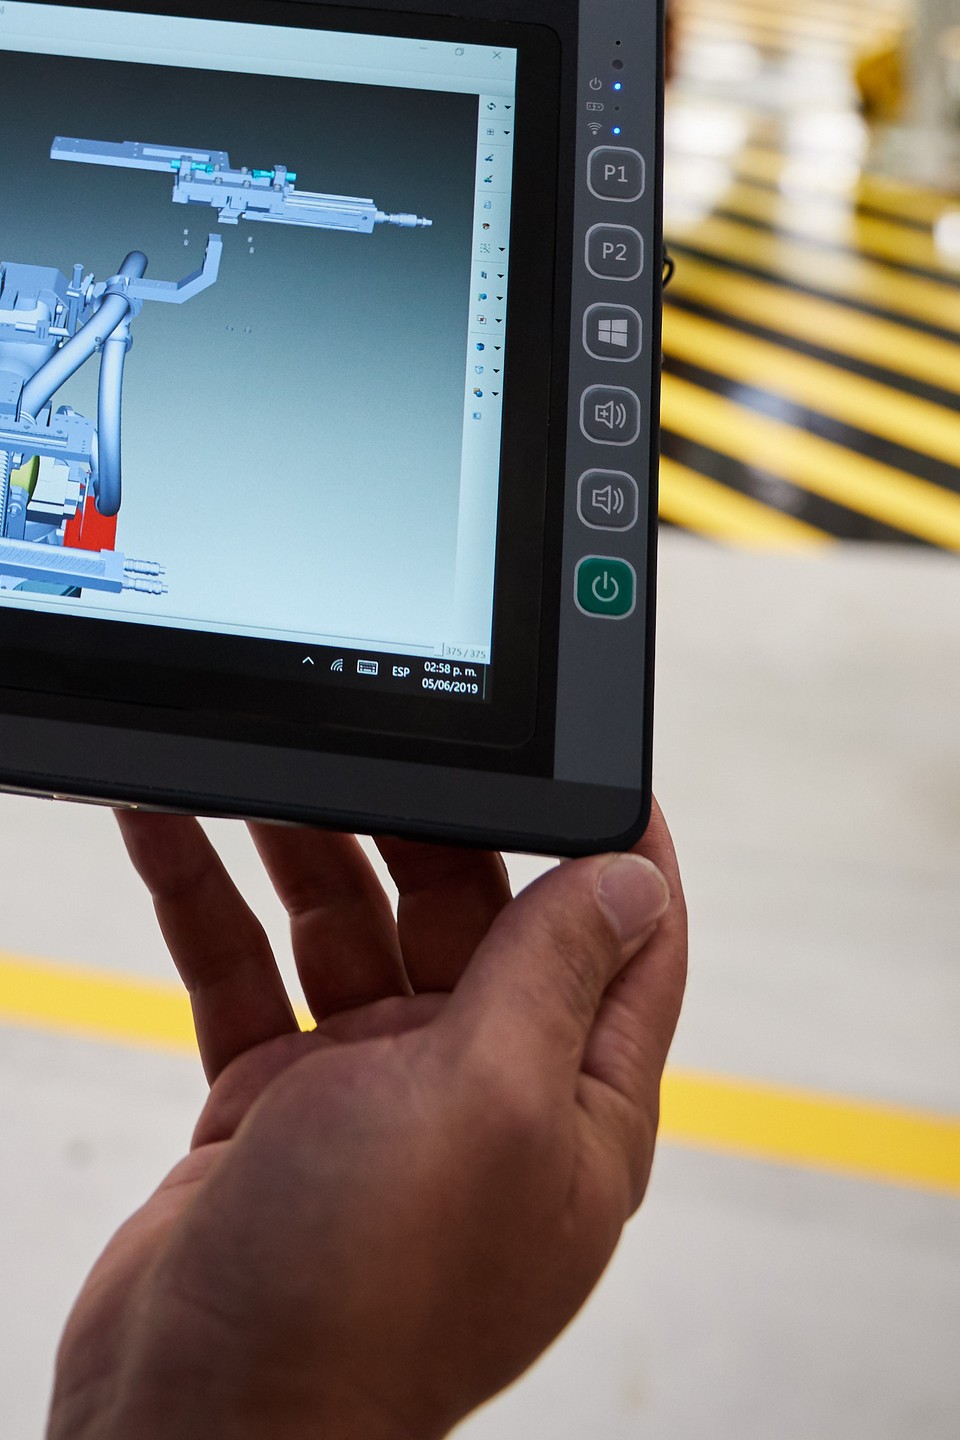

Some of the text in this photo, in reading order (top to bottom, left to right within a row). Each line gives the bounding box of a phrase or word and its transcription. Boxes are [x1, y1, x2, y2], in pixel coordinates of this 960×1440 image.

[604, 164, 629, 183] P1
[602, 242, 628, 261] P2
[445, 645, 462, 656] 375
[470, 648, 486, 659] 375
[392, 665, 410, 678] ESP
[424, 661, 477, 678] 02:58 p. m.
[422, 677, 479, 694] 05/06/2019
